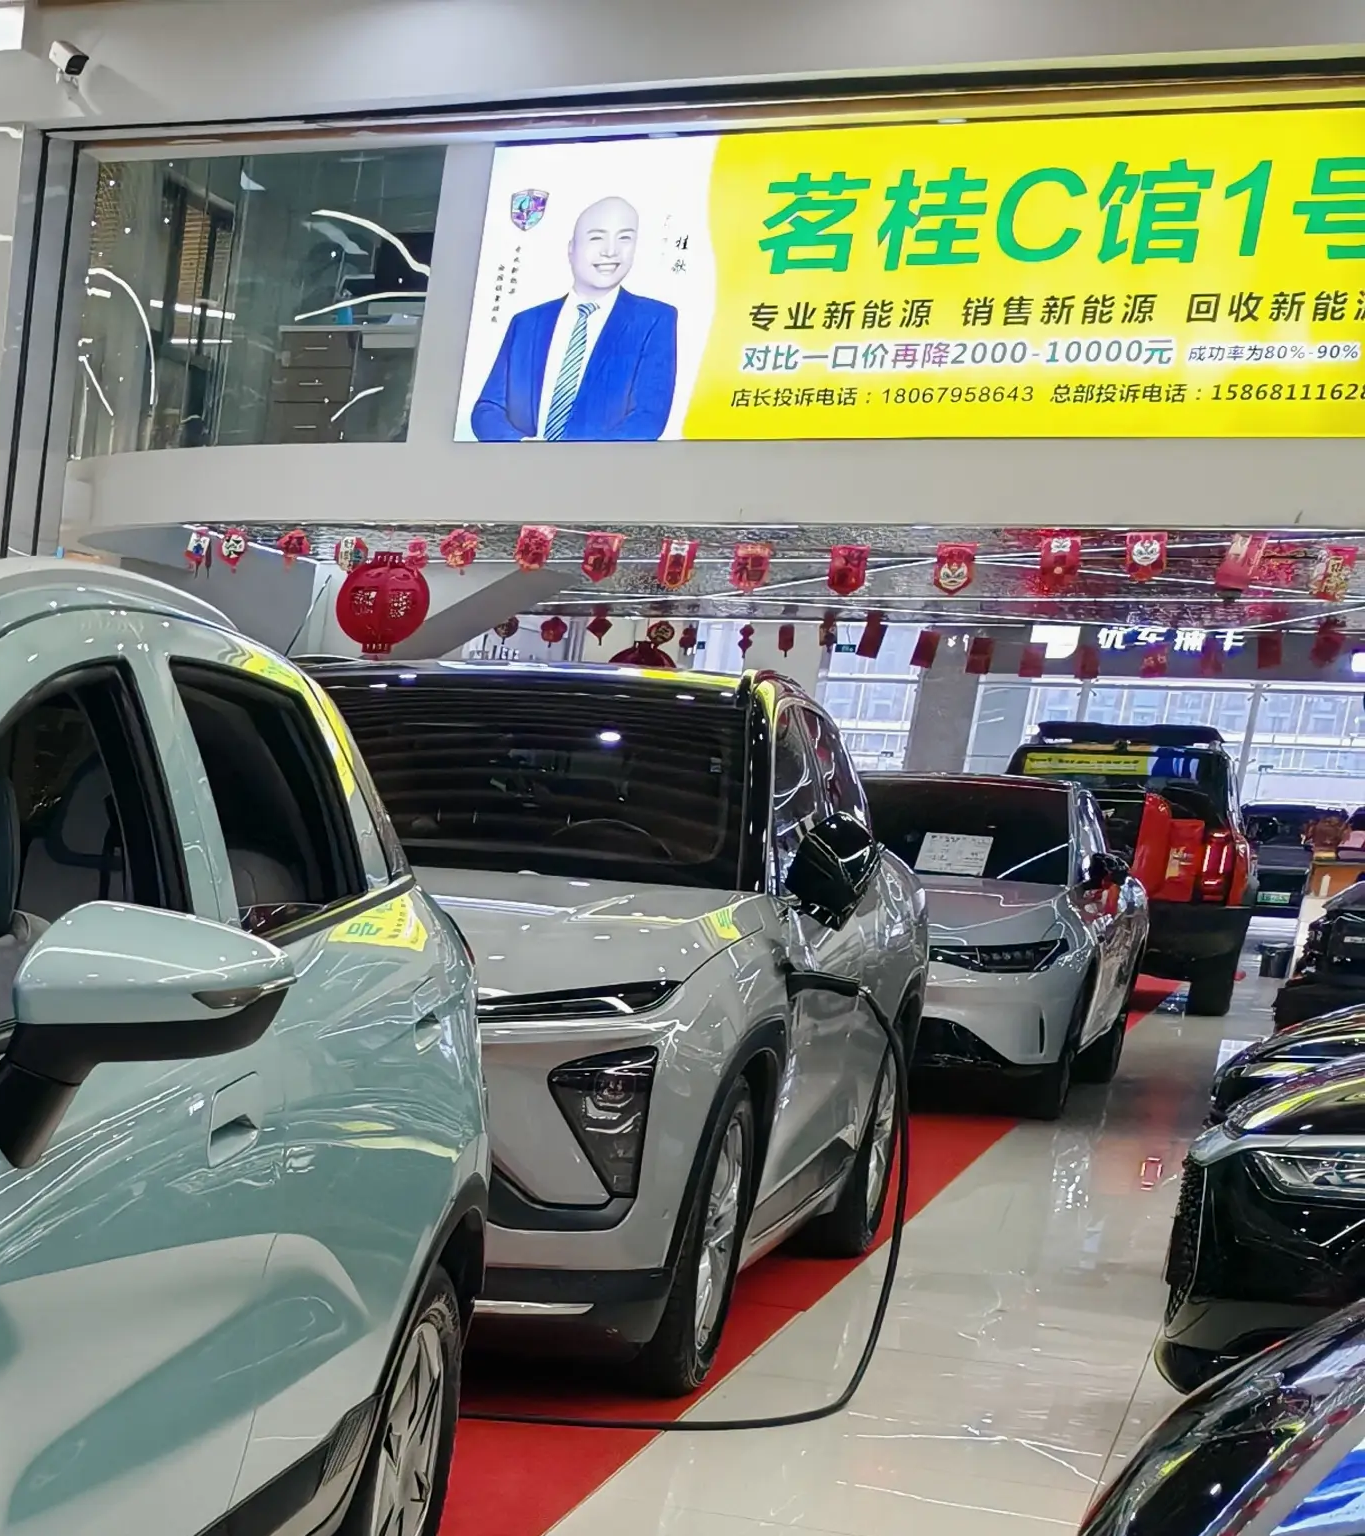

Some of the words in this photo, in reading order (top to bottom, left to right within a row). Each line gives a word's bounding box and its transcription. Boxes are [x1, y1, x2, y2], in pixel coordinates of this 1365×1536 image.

[758, 157, 1365, 275] 茗桂C馆1号
[748, 298, 934, 332] 专业新能源
[961, 293, 1158, 328] 销售新能源
[742, 339, 1173, 371] 对比一口价再降2000-10000元
[1187, 343, 1359, 362] 成功率为80%-90%
